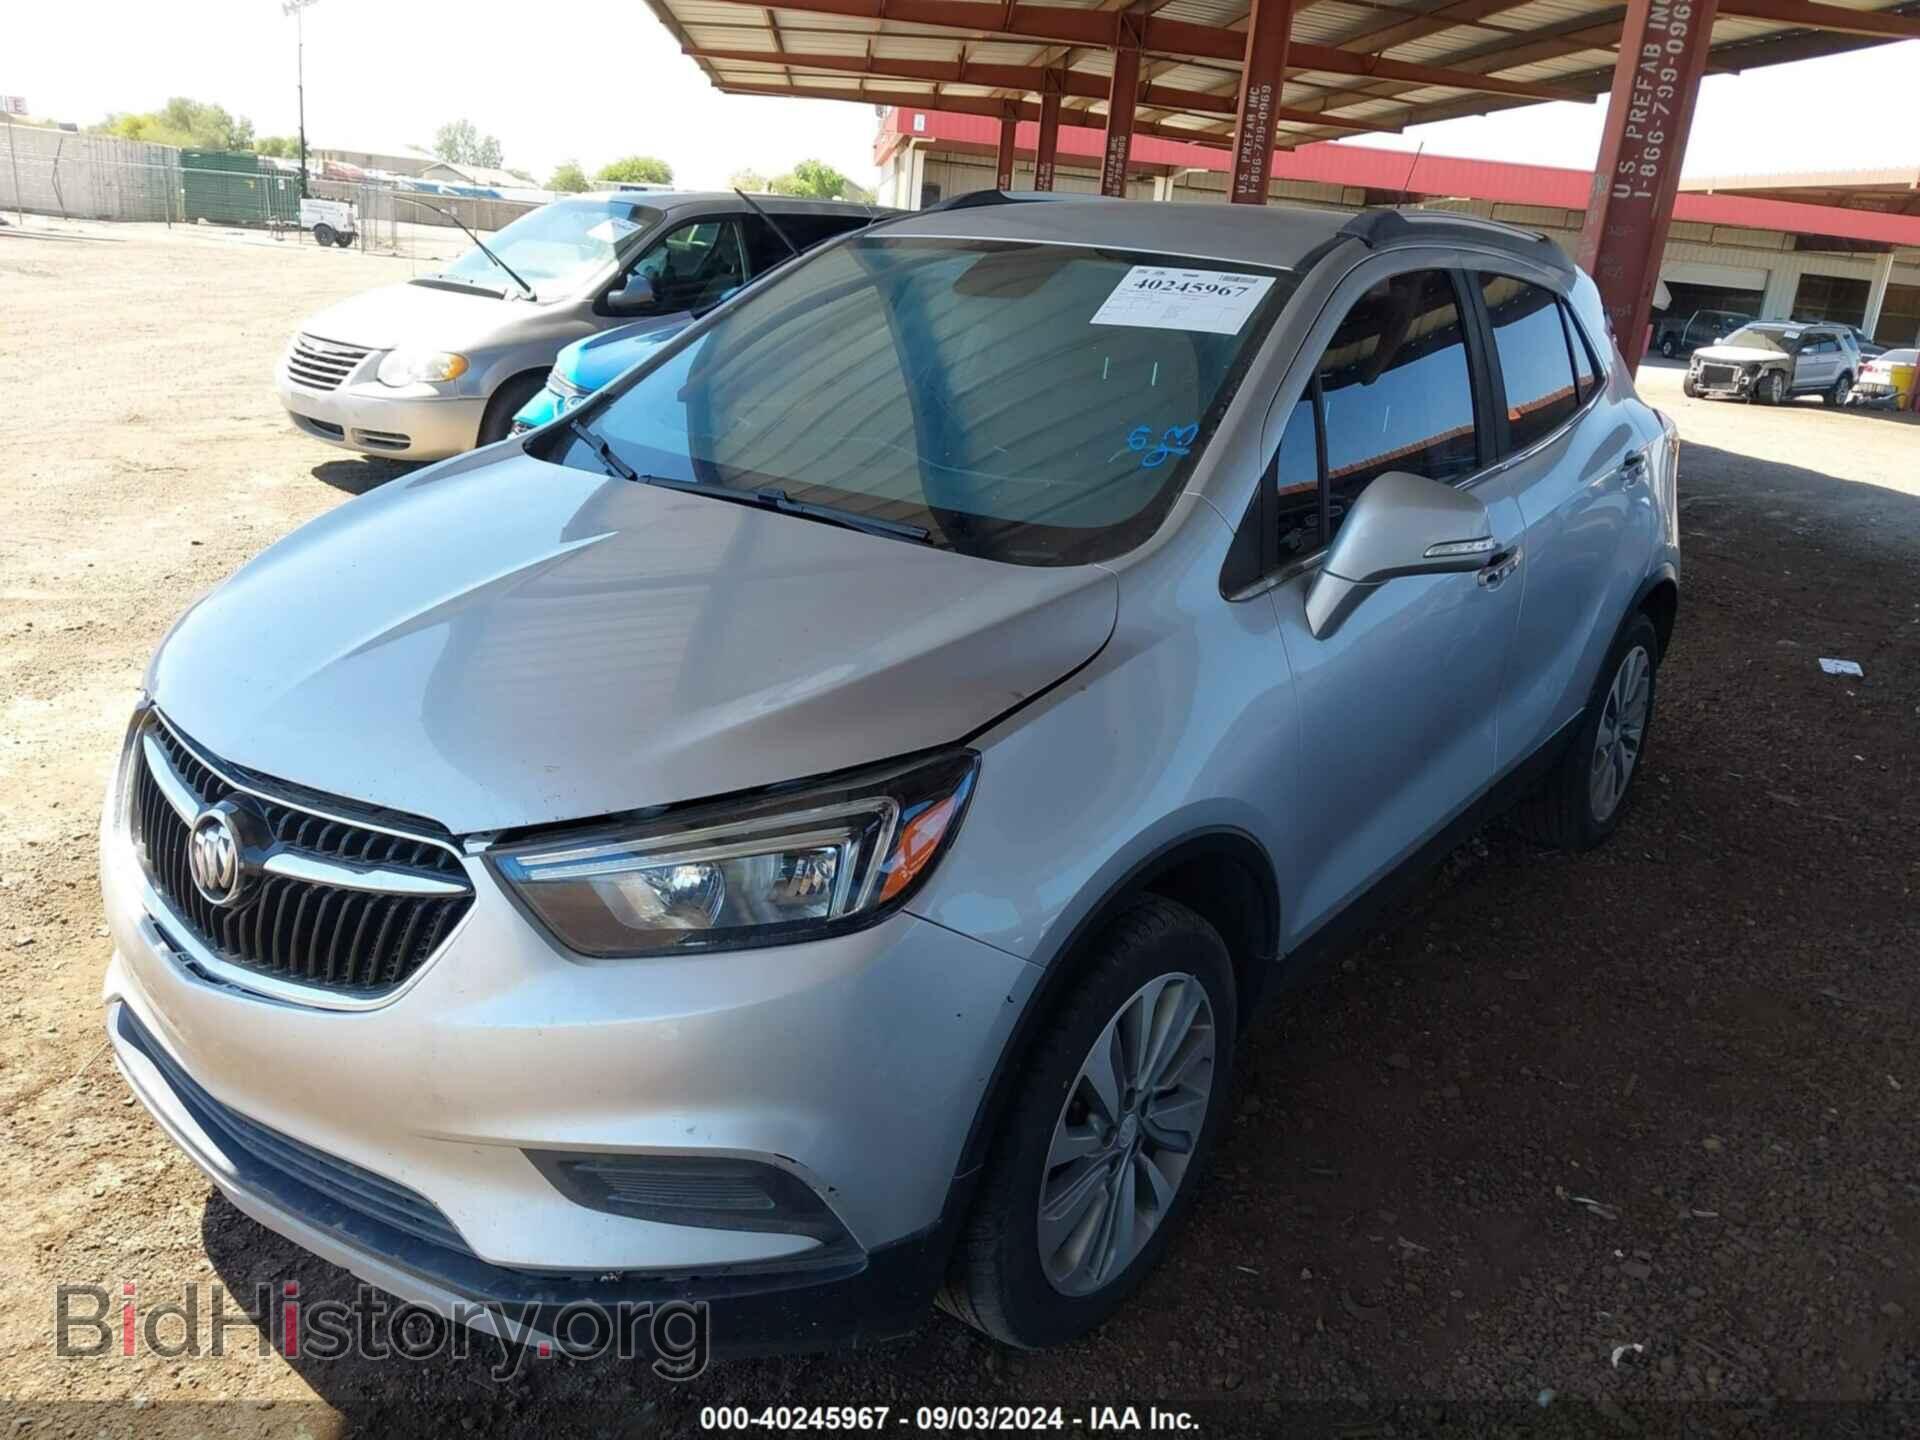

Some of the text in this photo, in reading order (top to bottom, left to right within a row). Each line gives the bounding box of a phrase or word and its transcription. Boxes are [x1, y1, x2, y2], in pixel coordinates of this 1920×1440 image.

[1248, 86, 1260, 108] INC
[1625, 43, 1661, 139] PREFAB
[1634, 0, 1692, 197] 1-866-799-096
[1240, 113, 1257, 164] PREFAB
[1134, 278, 1249, 297] 40245967
